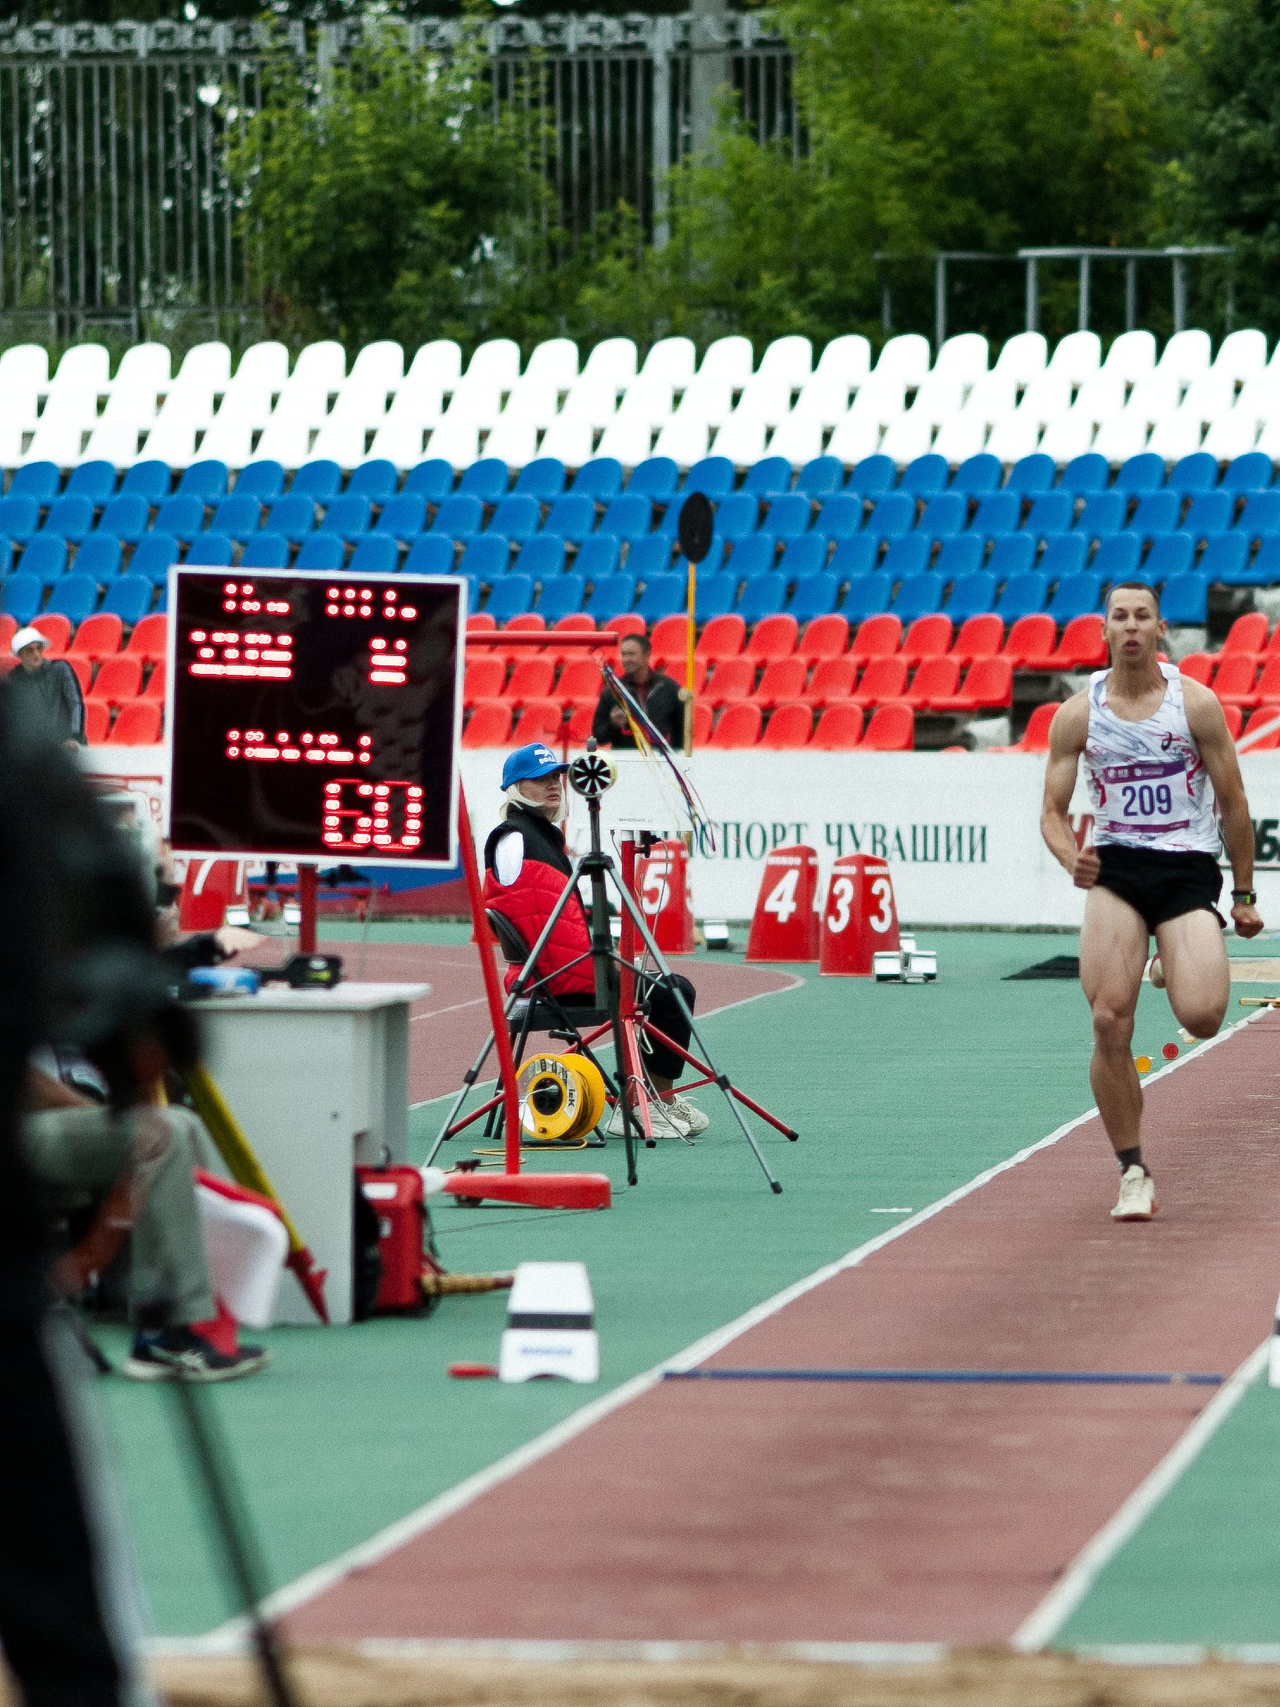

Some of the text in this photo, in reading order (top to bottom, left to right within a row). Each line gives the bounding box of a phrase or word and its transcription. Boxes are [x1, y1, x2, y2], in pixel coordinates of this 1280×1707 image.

[322, 778, 424, 852] 60
[1121, 784, 1172, 817] 209
[825, 823, 987, 863] ЧУВАШИИ
[642, 862, 673, 915] 5
[764, 869, 799, 923] 4
[827, 877, 854, 933] 3
[869, 877, 892, 933] 3
